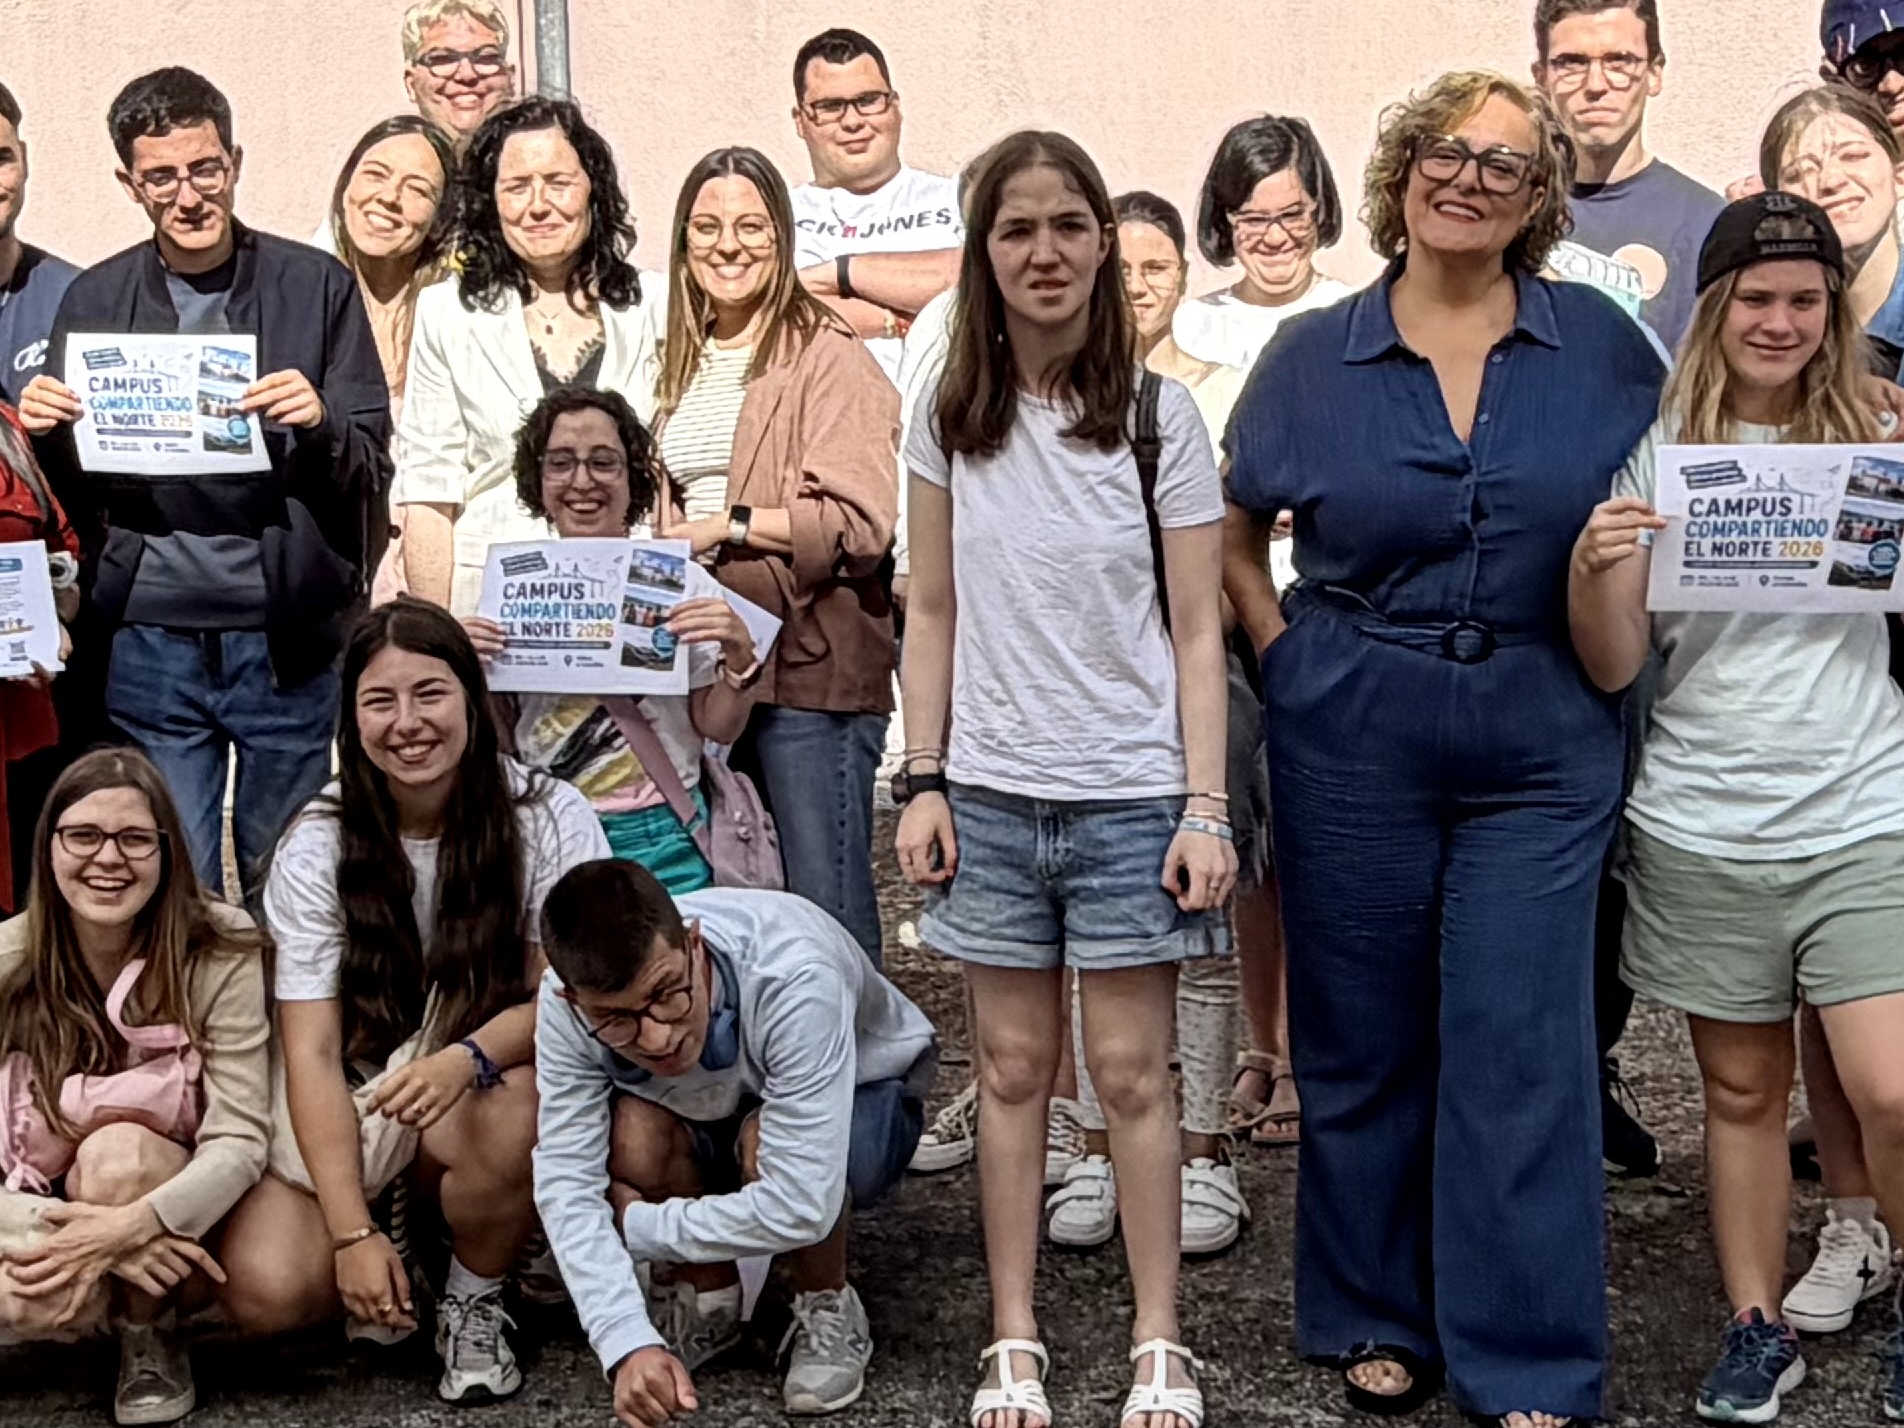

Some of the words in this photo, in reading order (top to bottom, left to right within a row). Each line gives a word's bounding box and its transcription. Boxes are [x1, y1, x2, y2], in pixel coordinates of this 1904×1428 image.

[859, 207, 953, 239] JONES
[88, 376, 163, 394] CAMPUS
[1688, 496, 1793, 518] CAMPUS
[1684, 517, 1830, 539] COMPARTIENDO
[1684, 540, 1706, 558] EL
[1710, 540, 1773, 558] NORTE
[502, 581, 586, 601] CAMPUS
[500, 602, 616, 620] COMPARTIENDO
[521, 621, 572, 638] NORTE
